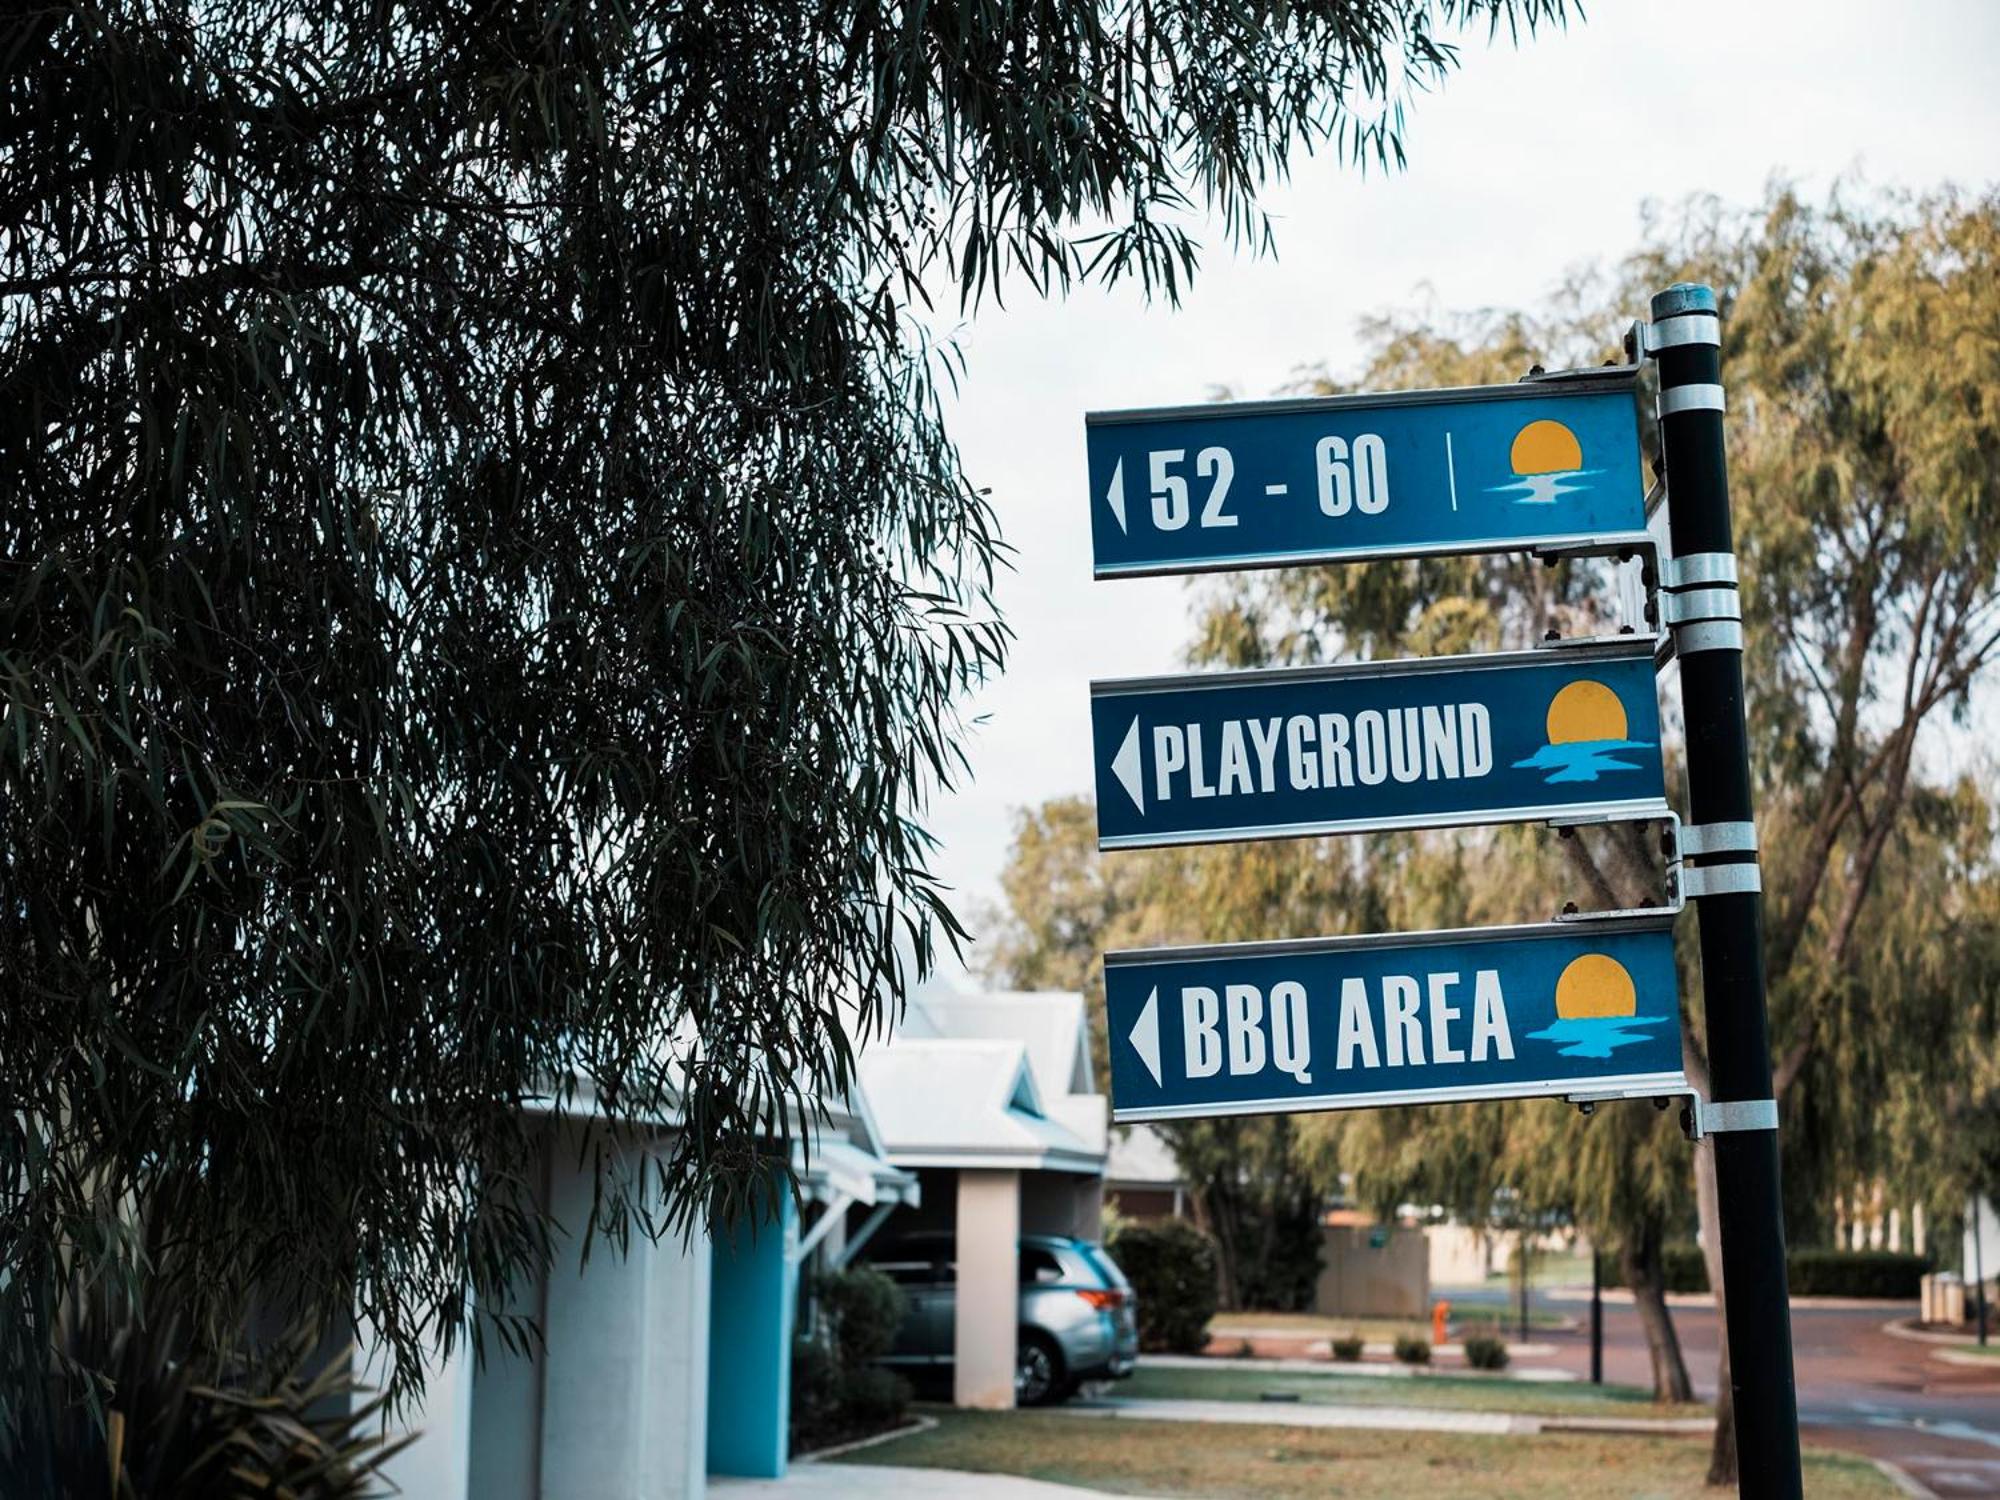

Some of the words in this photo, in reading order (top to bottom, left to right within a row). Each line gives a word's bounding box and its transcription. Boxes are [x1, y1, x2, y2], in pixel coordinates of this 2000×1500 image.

[1149, 446, 1238, 531] 52
[1265, 484, 1287, 495] -
[1315, 434, 1389, 517] 60
[1153, 702, 1493, 801] PLAYGROUND
[1181, 981, 1312, 1084] BBQ
[1336, 970, 1515, 1070] AREA
